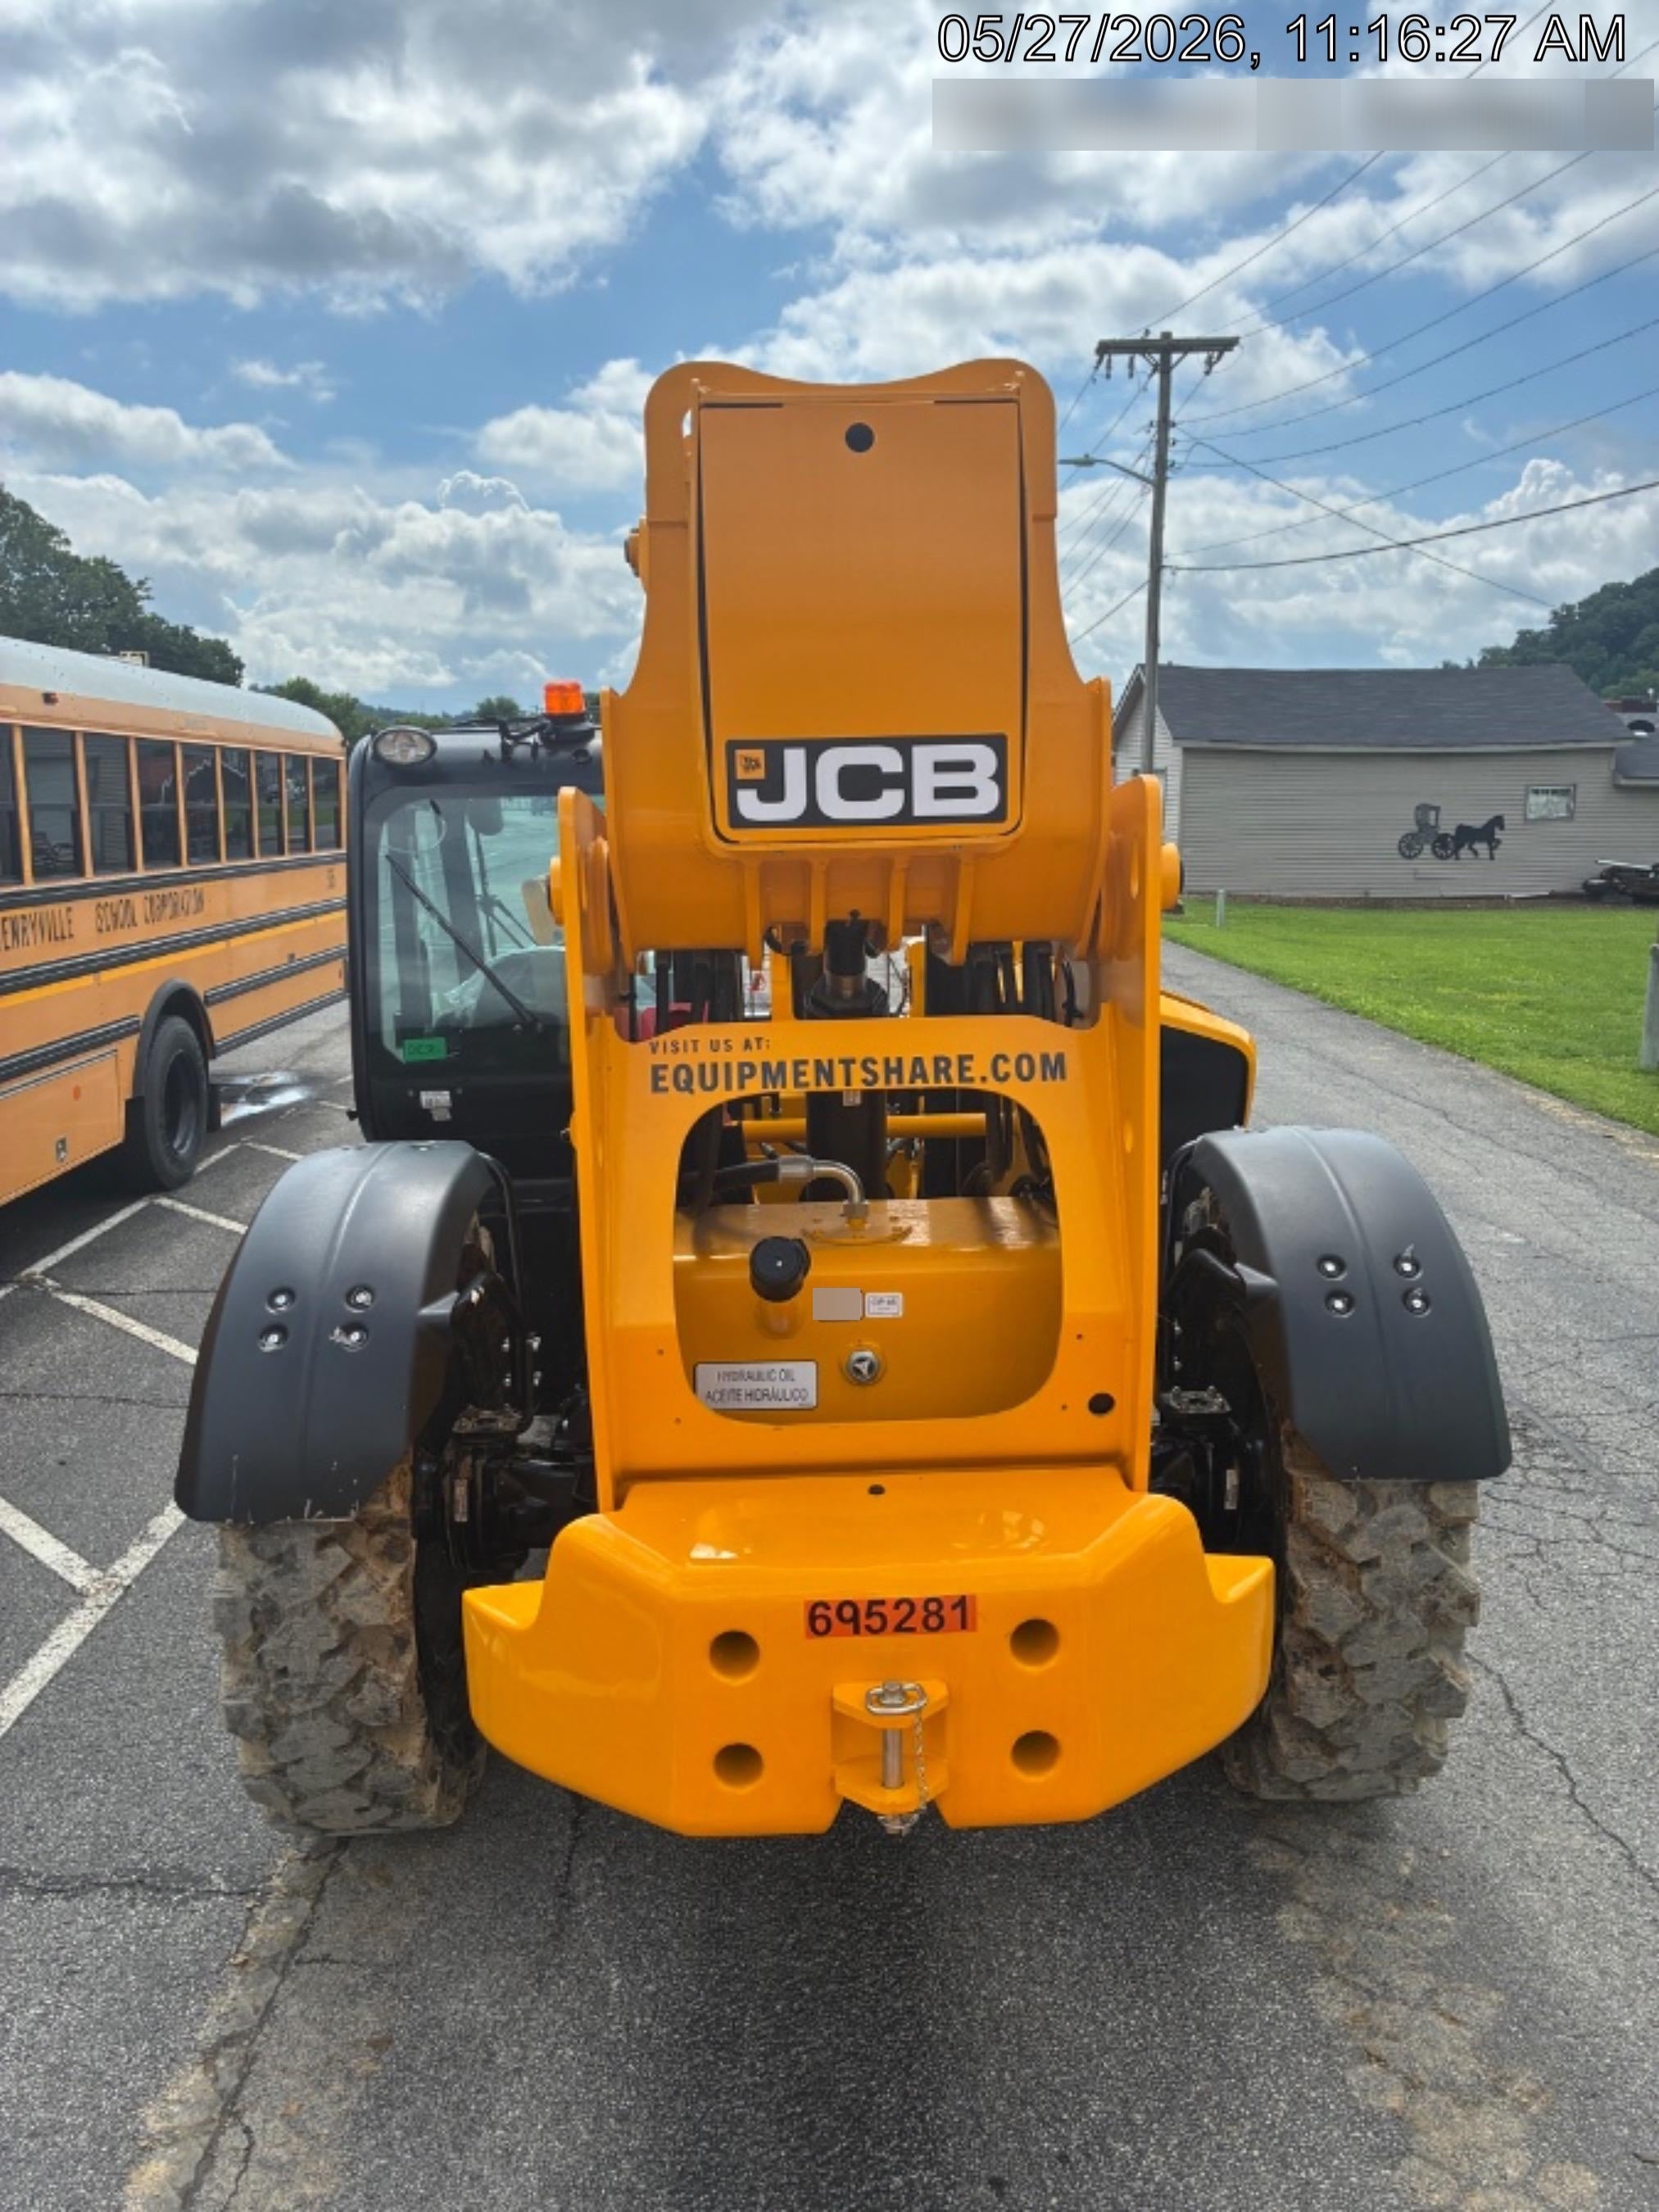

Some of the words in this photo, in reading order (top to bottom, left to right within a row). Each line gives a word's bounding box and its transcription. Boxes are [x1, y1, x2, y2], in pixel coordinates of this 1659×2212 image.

[737, 744, 1000, 822] JCB
[0, 907, 75, 952] ENRYVILLE
[95, 899, 138, 934] SCHOOL
[650, 1039, 700, 1054] VISIT
[709, 1039, 733, 1052] US
[743, 1036, 770, 1051] AT:
[650, 1052, 1067, 1095] EQUIPMENTSHARE.COM
[717, 1369, 777, 1382] HYDRAULIC
[779, 1368, 796, 1382] OIL
[808, 1595, 968, 1637] 695281
